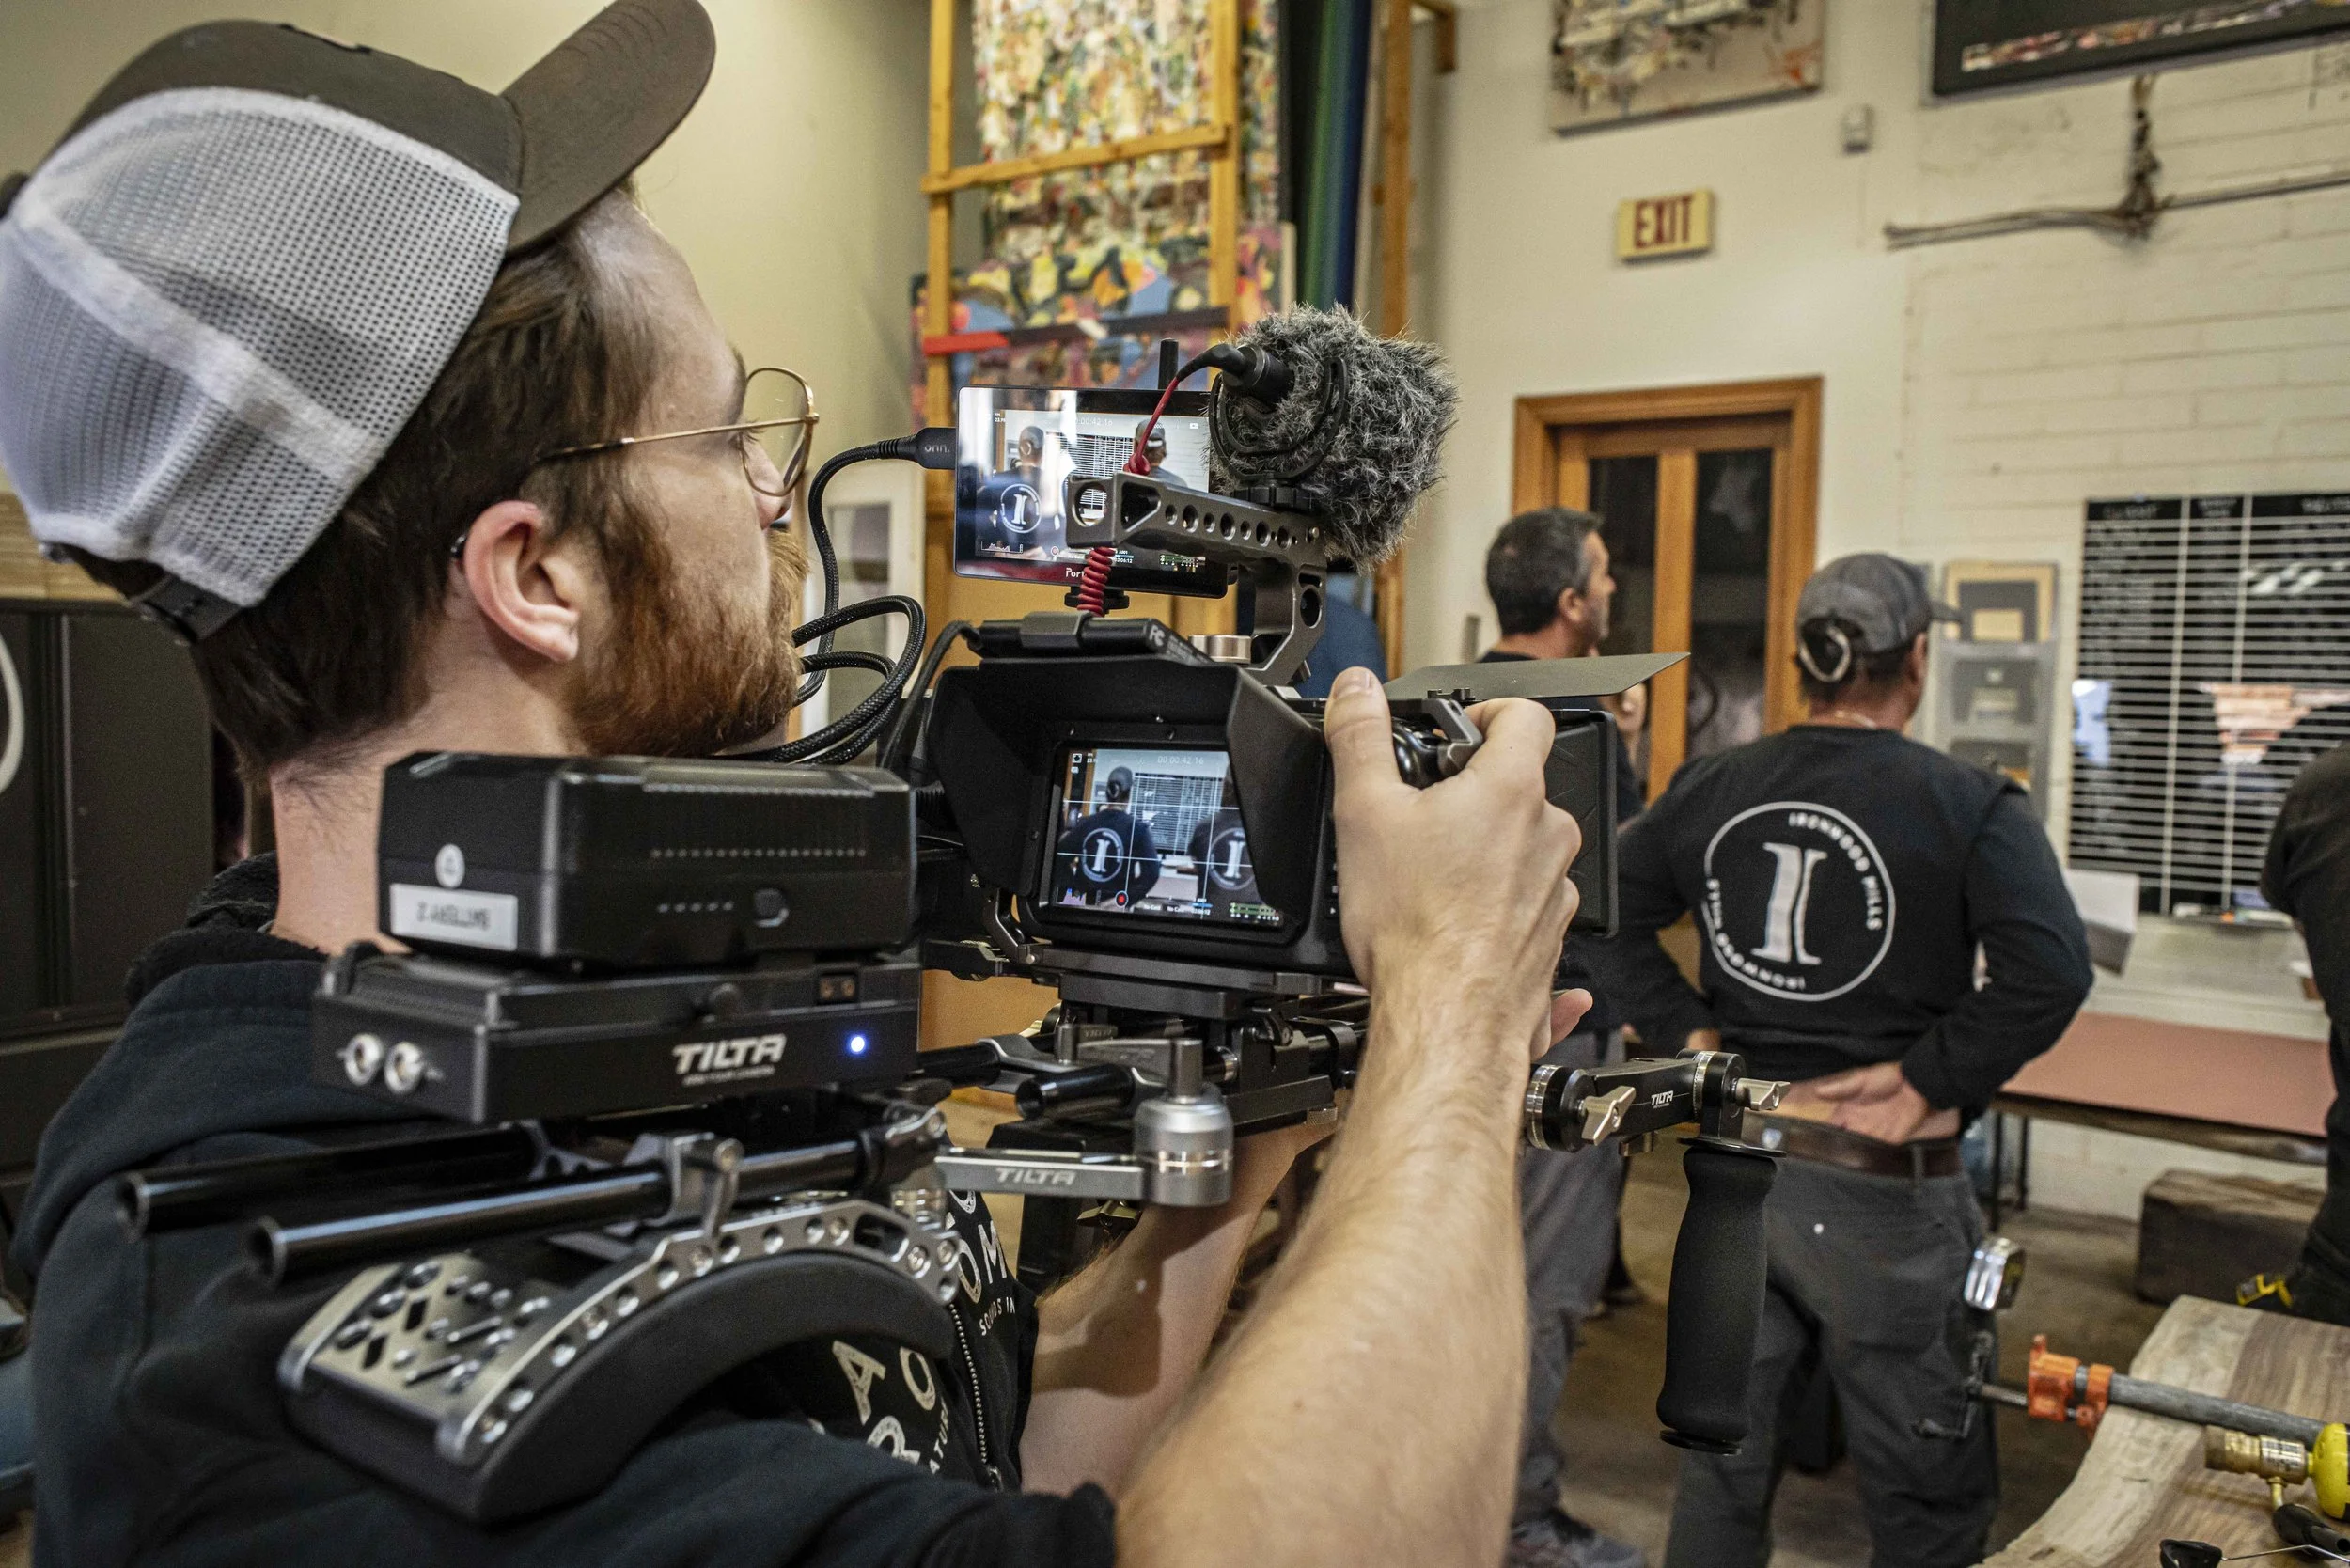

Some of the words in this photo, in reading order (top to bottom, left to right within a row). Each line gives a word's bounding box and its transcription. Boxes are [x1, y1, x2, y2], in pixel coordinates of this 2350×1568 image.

[1634, 192, 1696, 248] EXIT
[1065, 567, 1085, 578] Port
[672, 1033, 788, 1074] TILTA
[1651, 1090, 1674, 1106] TILTA
[996, 1167, 1076, 1185] TILTA
